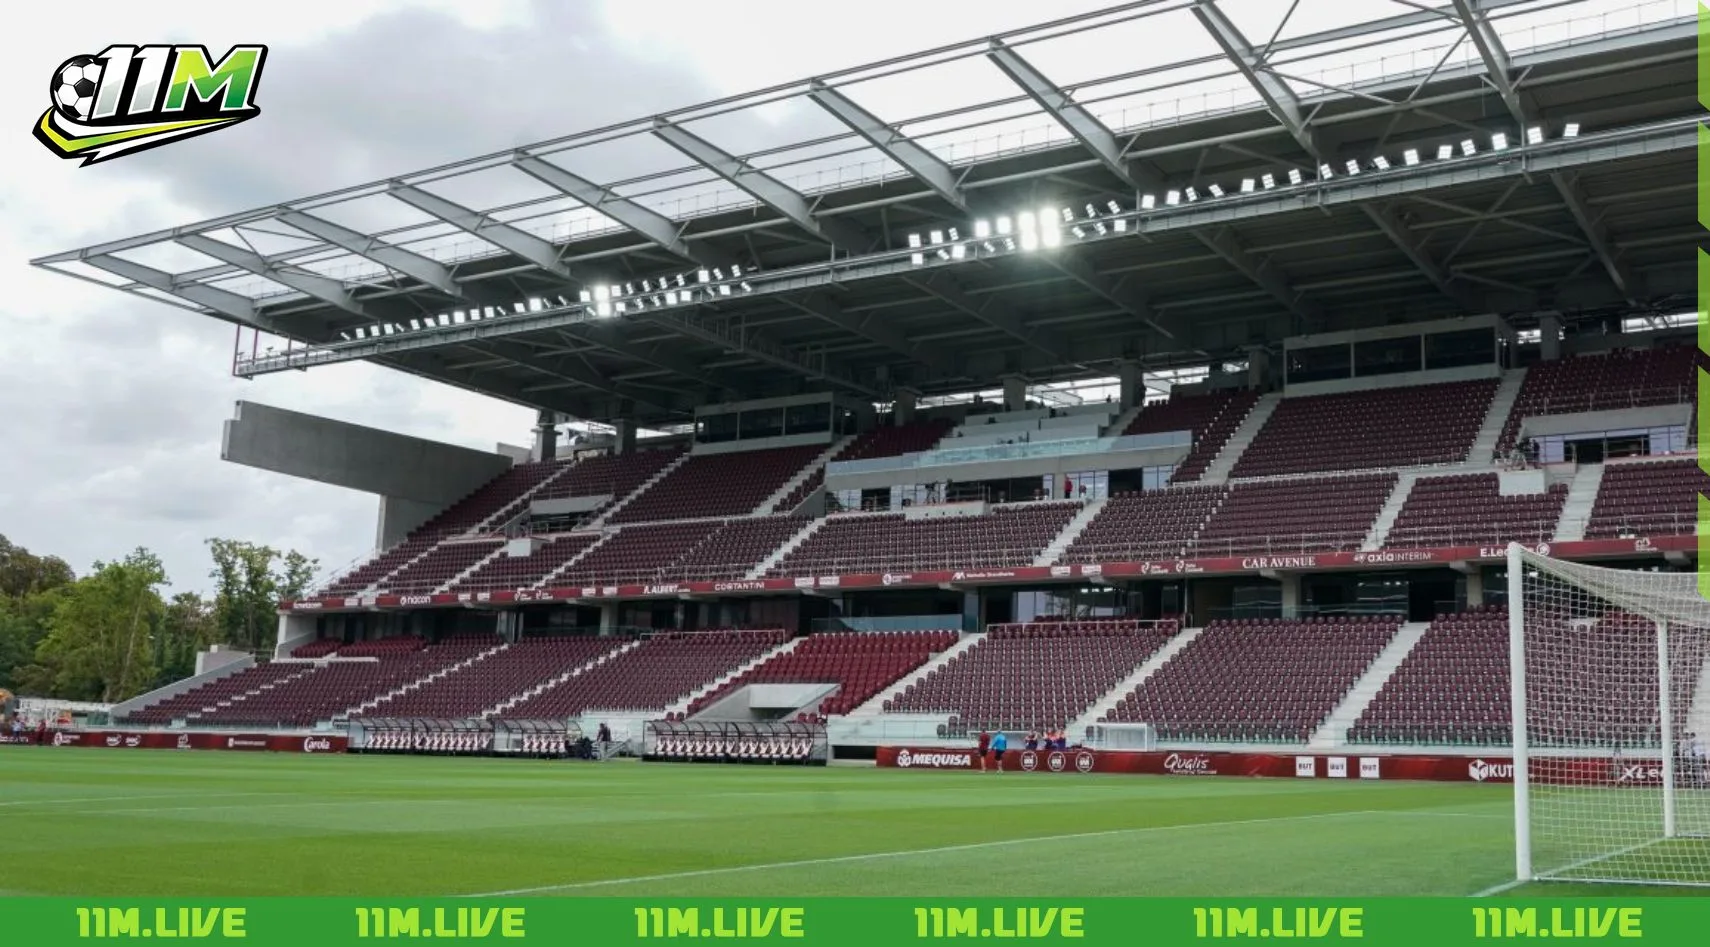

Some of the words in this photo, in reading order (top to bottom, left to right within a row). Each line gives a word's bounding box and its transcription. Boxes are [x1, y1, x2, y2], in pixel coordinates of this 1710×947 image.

[1242, 557, 1268, 568] CAR
[1270, 556, 1315, 567] AVENUE
[715, 582, 764, 591] COSTANTINI
[407, 595, 430, 605] nacon
[304, 737, 330, 752] Carola
[912, 754, 971, 767] MEQUISA
[1164, 753, 1209, 772] Qualis
[1489, 764, 1515, 777] KUT
